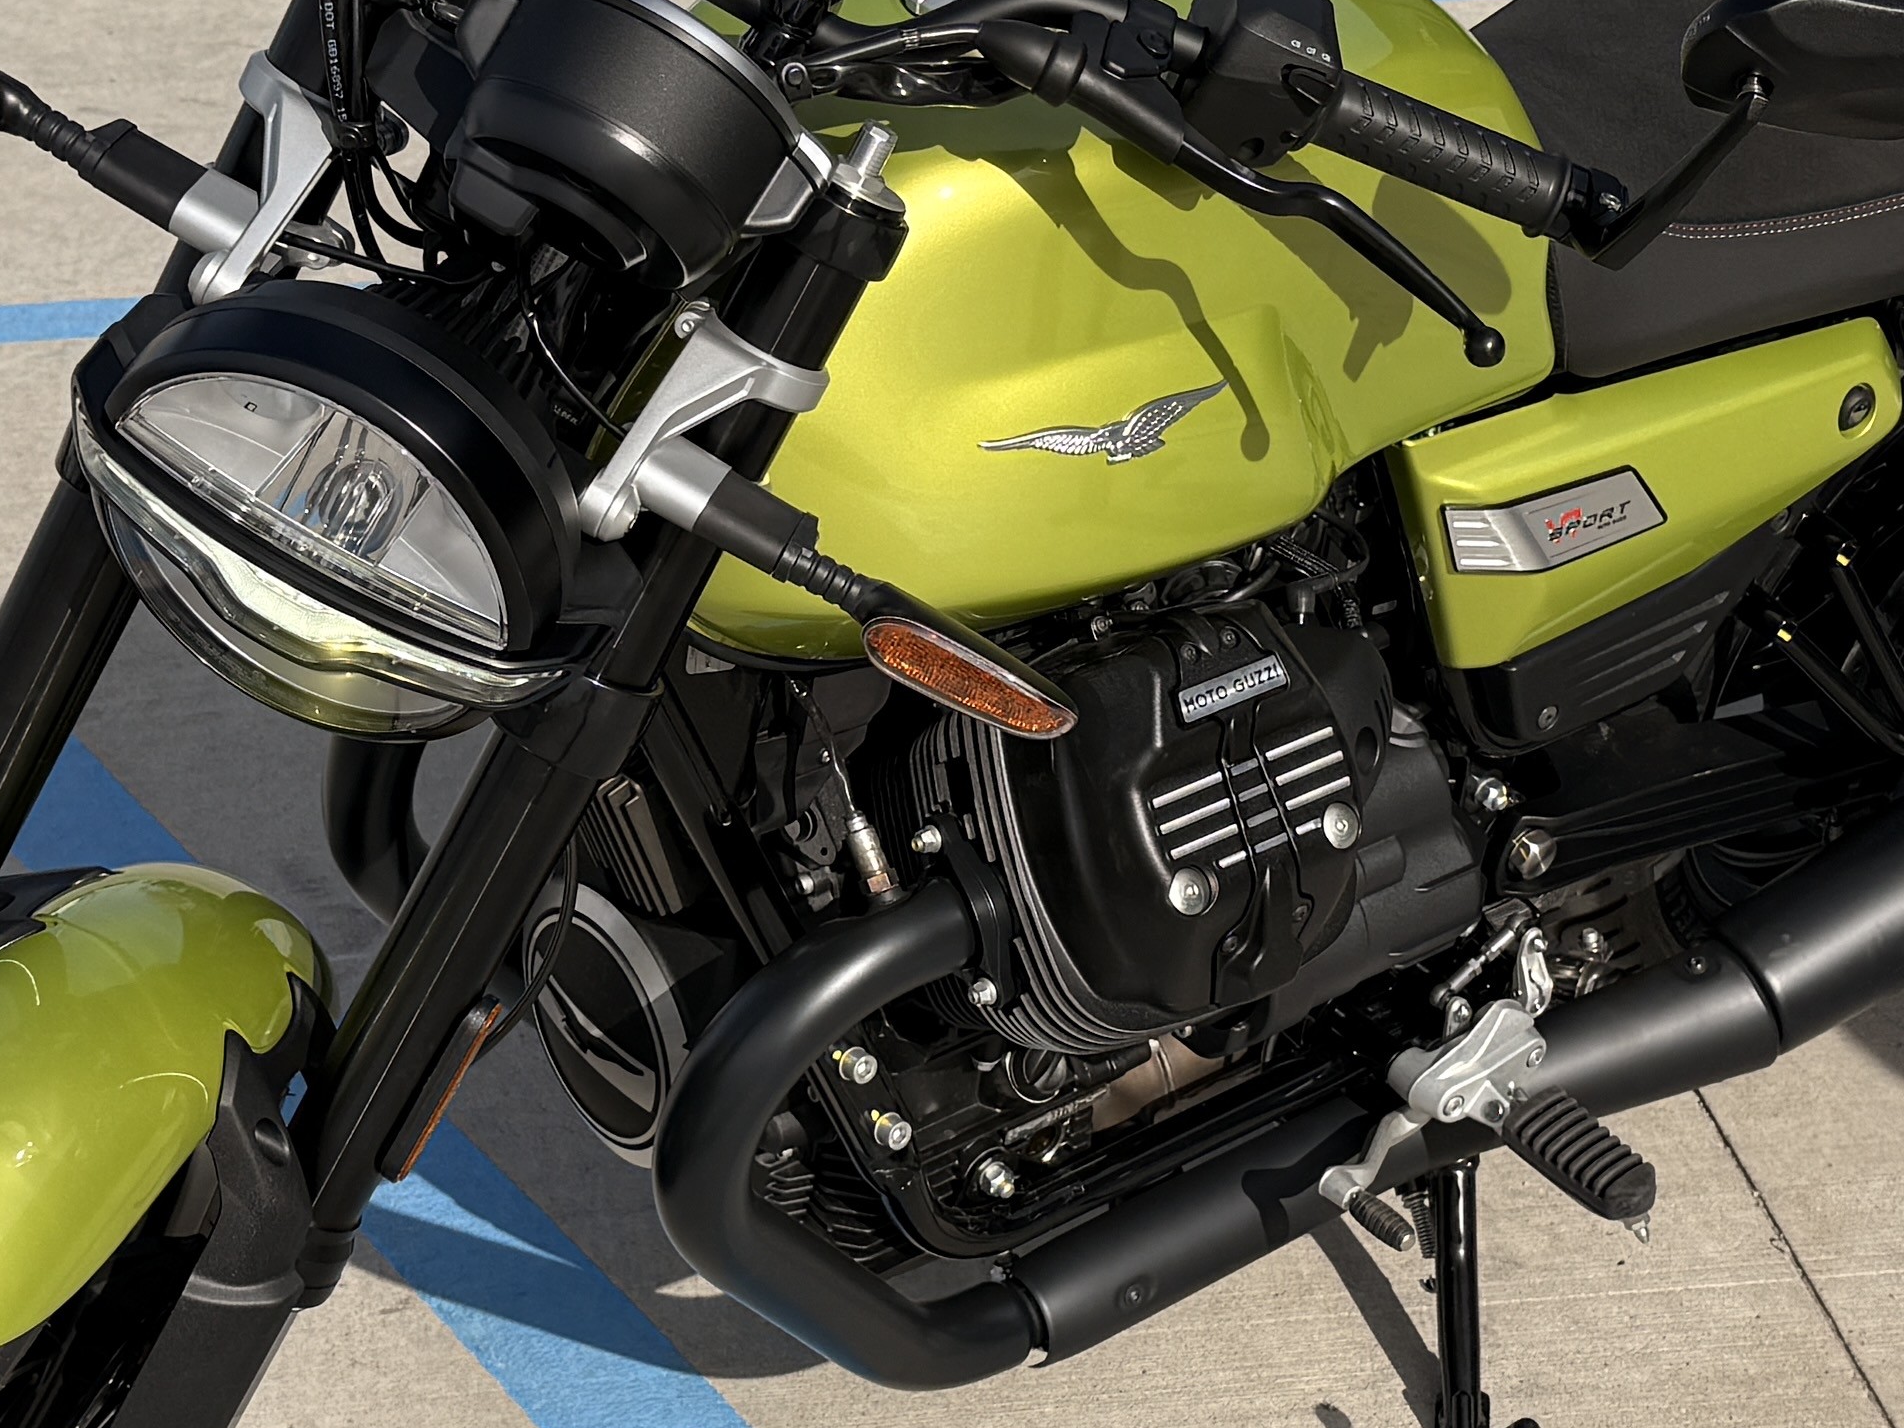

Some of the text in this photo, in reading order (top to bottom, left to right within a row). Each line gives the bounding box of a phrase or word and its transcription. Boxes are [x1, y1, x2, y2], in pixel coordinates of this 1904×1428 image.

[325, 2, 334, 29] DOT
[1548, 500, 1631, 541] SPORT
[1183, 663, 1281, 713] MOTO GUZZI
